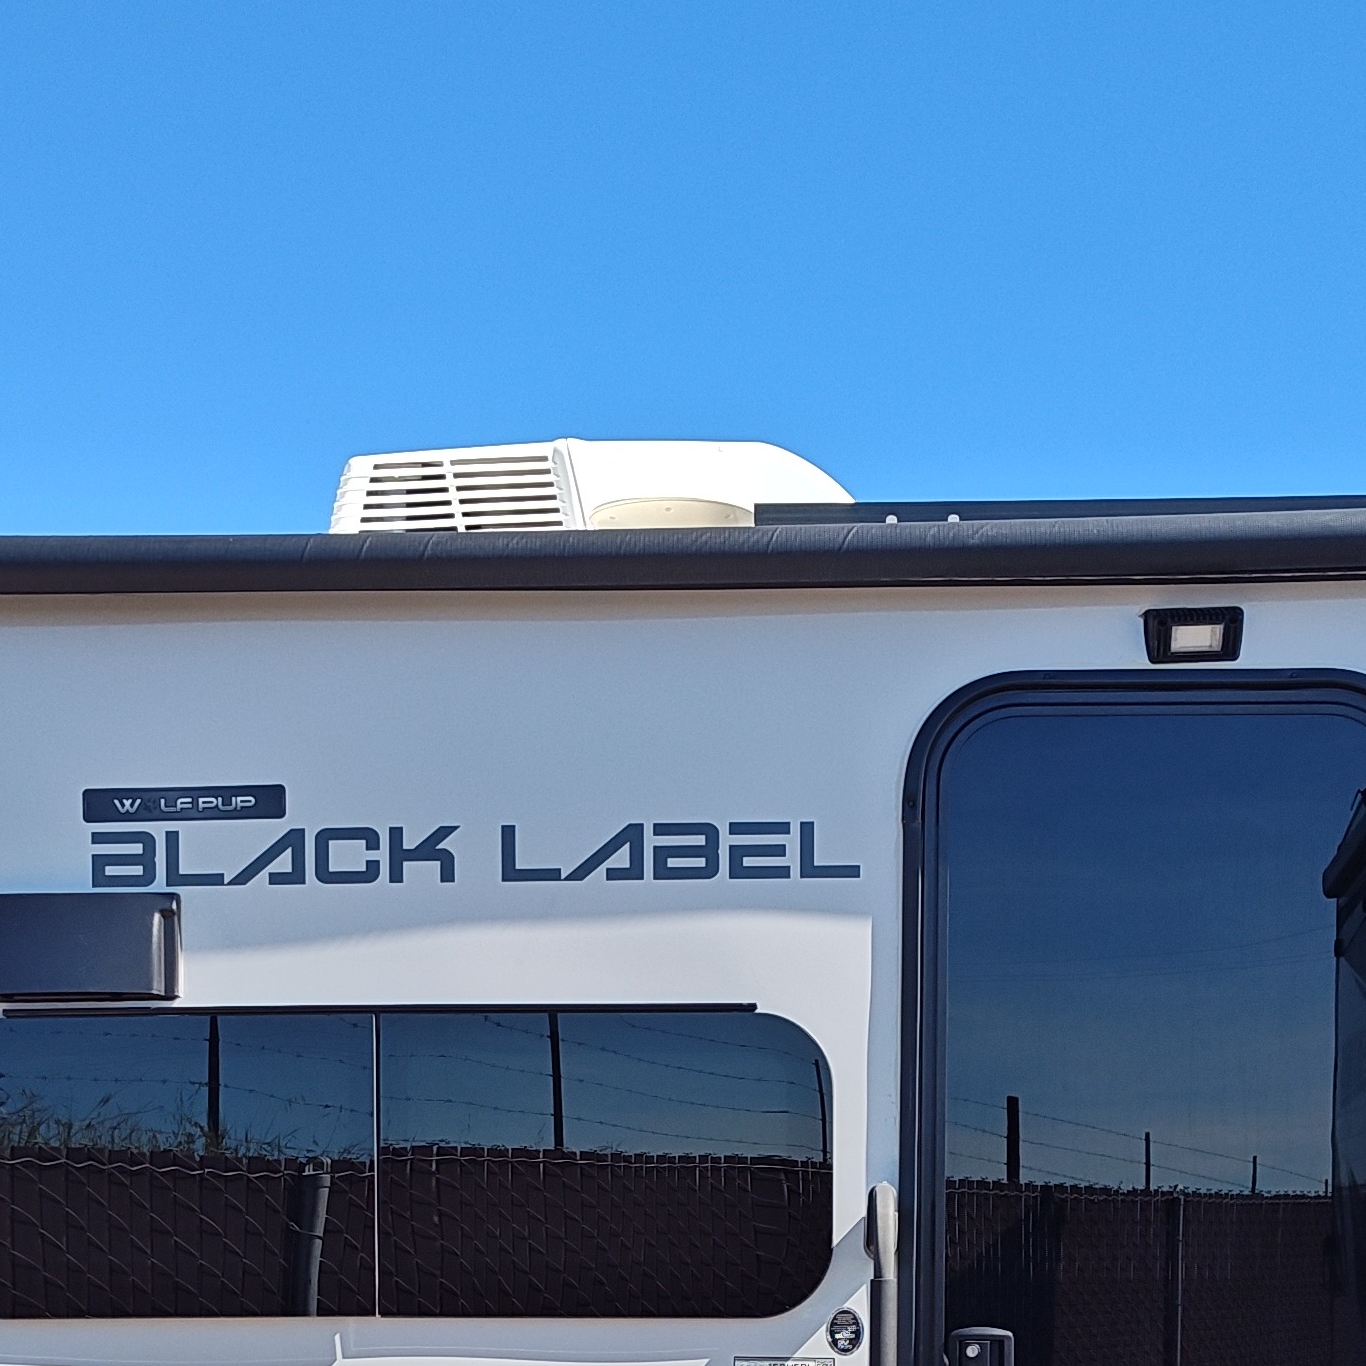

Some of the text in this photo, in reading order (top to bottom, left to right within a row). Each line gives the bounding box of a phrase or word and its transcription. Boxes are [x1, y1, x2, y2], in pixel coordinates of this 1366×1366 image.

[198, 796, 256, 812] PUP
[91, 820, 861, 889] BLACK LABEL
